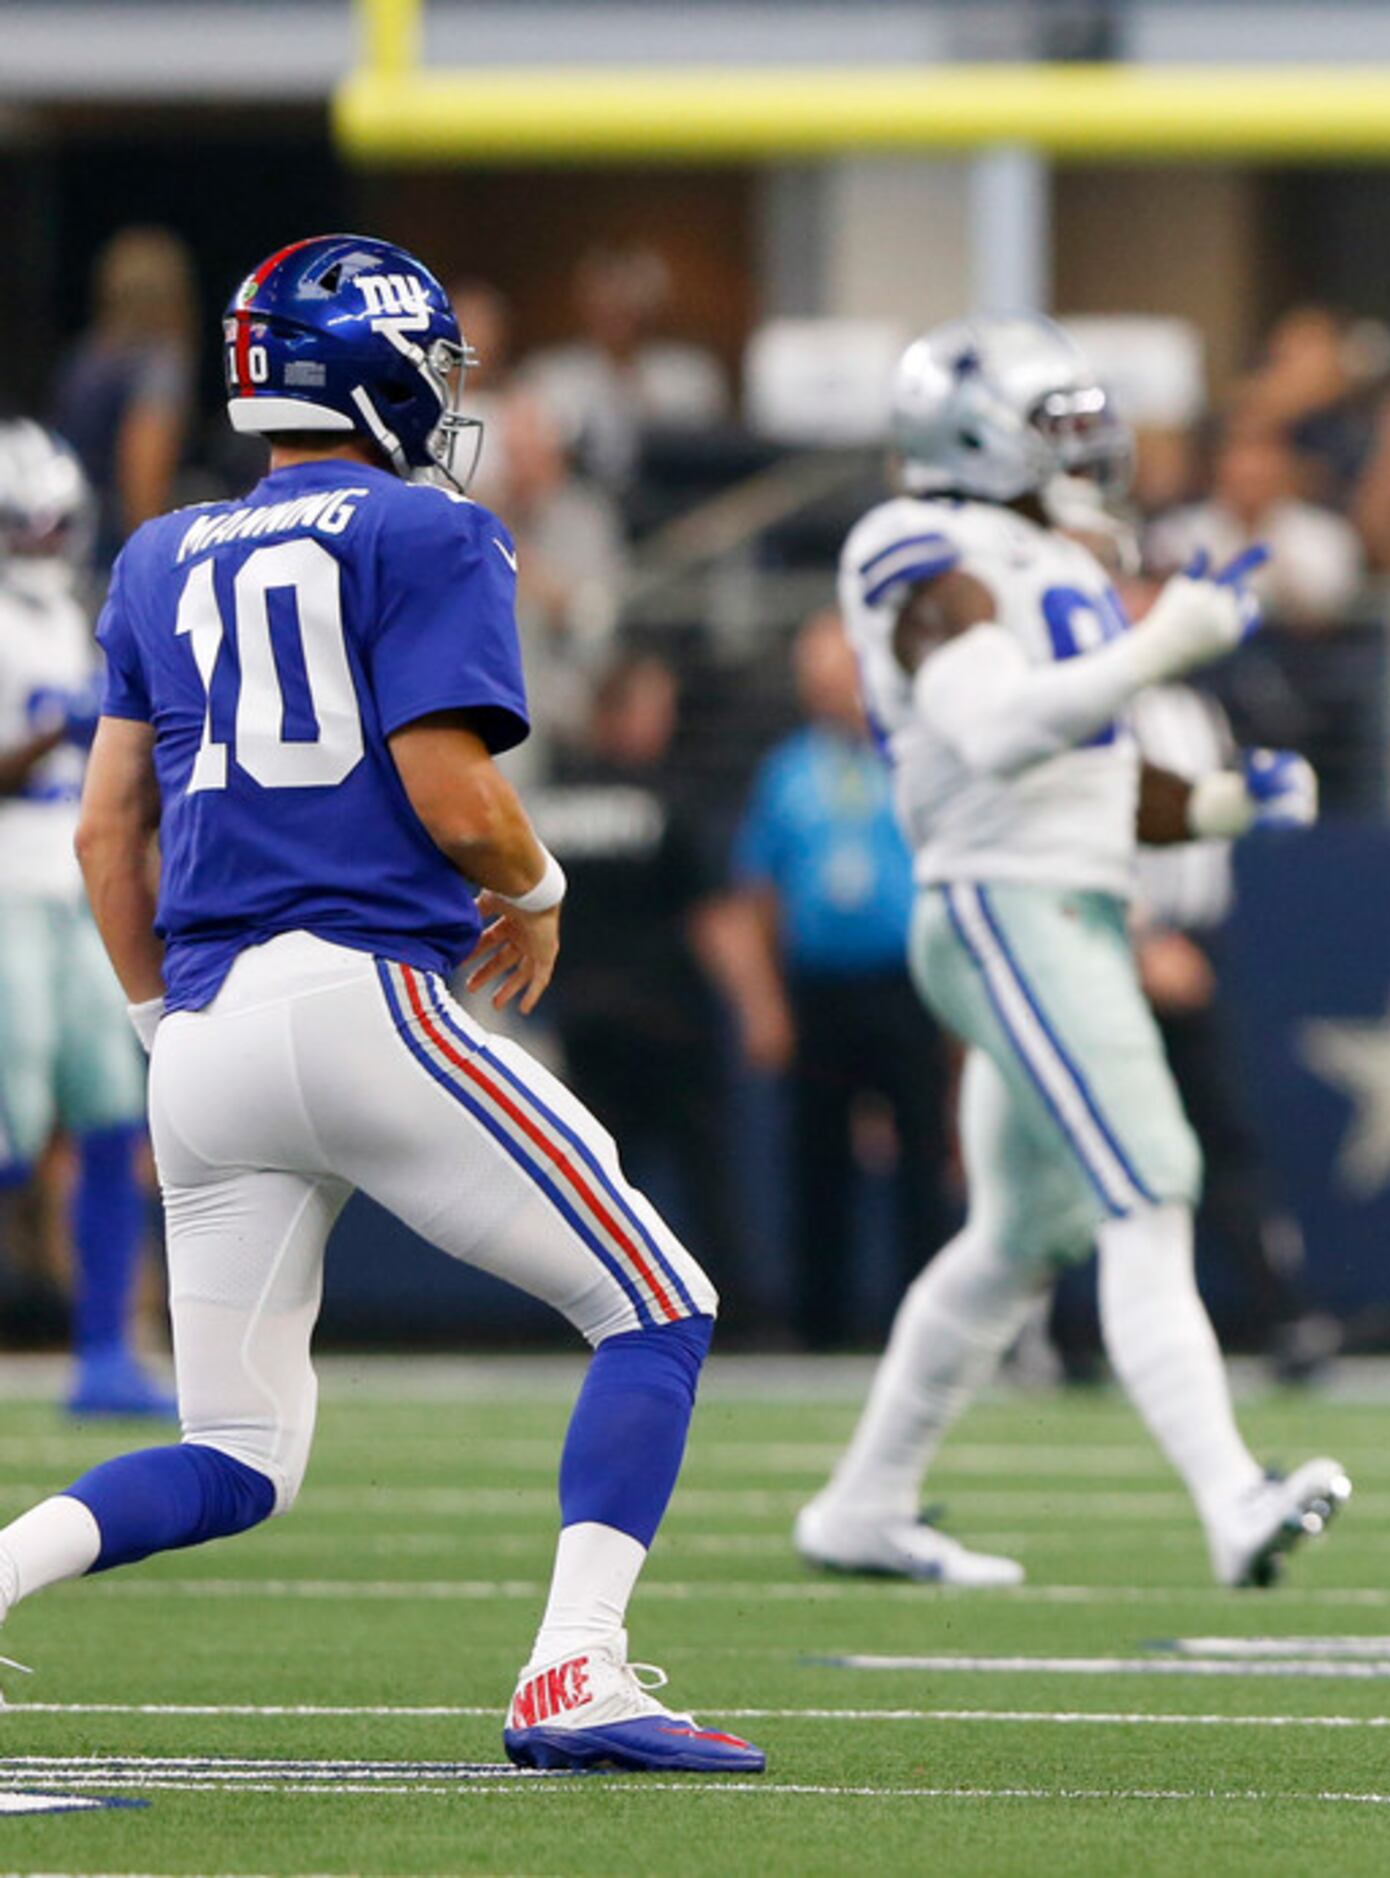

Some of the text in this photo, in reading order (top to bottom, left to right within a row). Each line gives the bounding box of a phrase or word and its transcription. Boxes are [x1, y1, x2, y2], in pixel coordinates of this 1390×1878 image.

[229, 345, 269, 384] 10
[176, 487, 370, 563] MANNING
[174, 536, 365, 795] 10
[511, 1655, 594, 1730] NIKE
